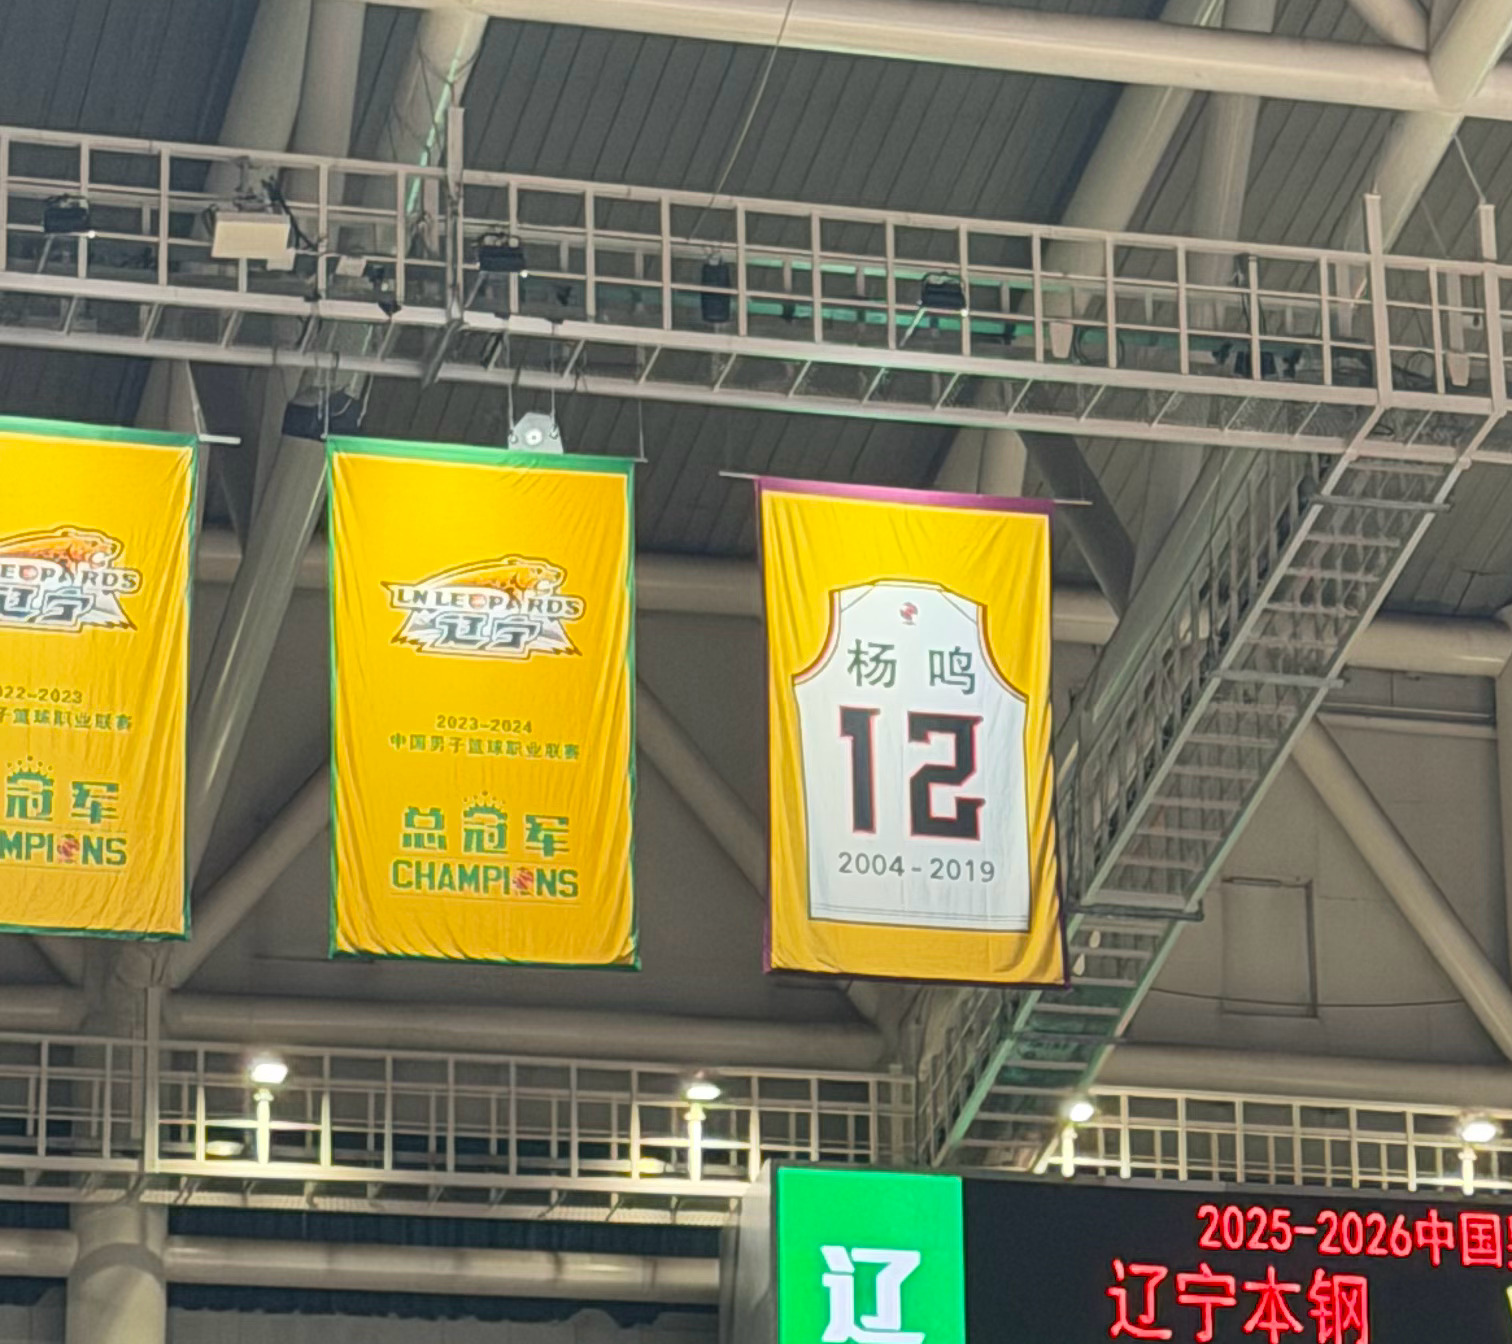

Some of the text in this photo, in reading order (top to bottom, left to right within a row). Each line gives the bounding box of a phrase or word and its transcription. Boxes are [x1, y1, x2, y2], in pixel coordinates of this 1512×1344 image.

[0, 563, 137, 588] EOPARDS
[399, 587, 581, 616] LN LEOPARDS
[435, 612, 541, 649] 辽宁
[0, 685, 82, 704] 22-2023
[436, 714, 533, 734] 2023-2024
[390, 733, 580, 760] 中国男子篮球职业联赛
[839, 705, 985, 841] 12
[402, 803, 571, 858] 总冠军
[392, 859, 579, 897] CHAMPIONS
